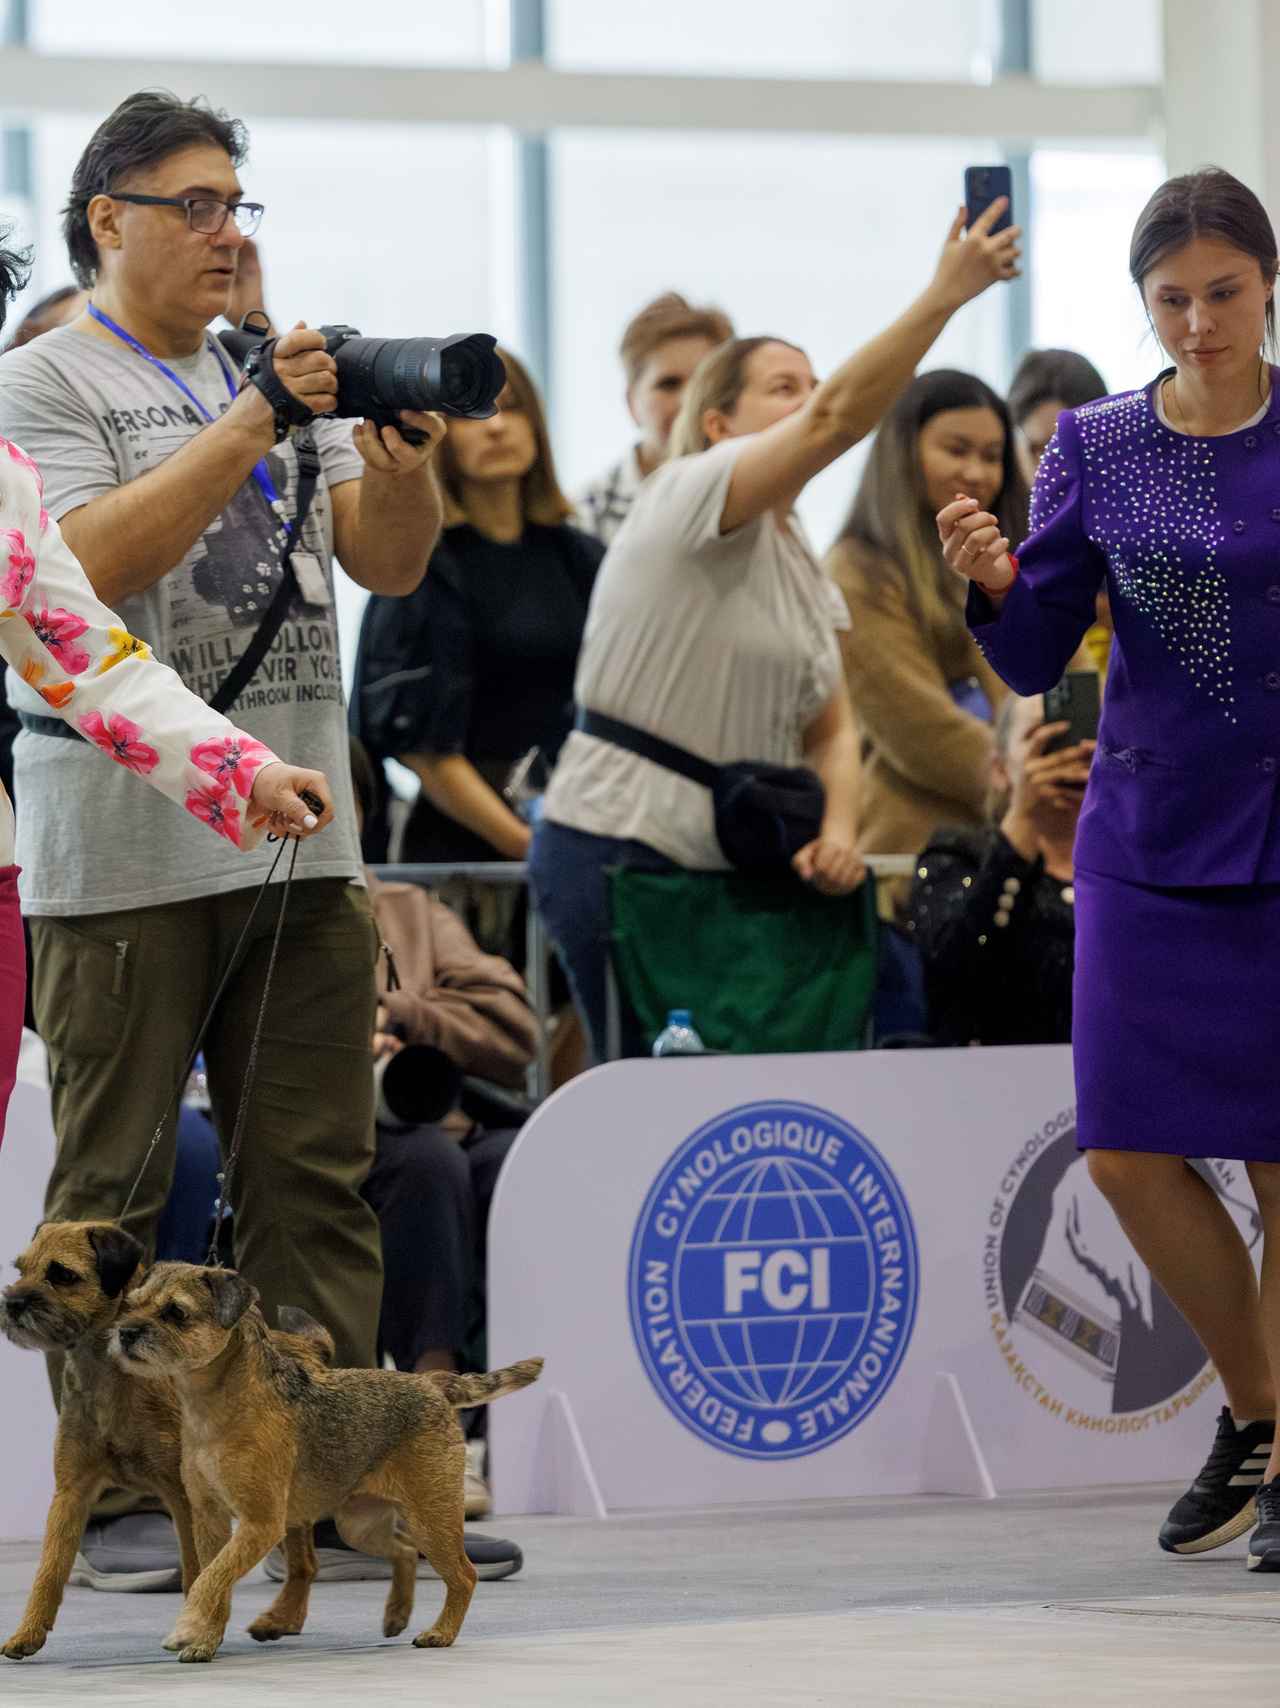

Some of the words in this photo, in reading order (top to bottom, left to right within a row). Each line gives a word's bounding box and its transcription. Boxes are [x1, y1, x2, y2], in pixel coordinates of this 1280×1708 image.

[101, 404, 204, 435] ERSONA
[170, 637, 241, 685] WILL
[655, 1120, 844, 1238] CYNOLOGIQUE
[1000, 1107, 1076, 1194] CYNOLOGI
[989, 1197, 1005, 1228] OF
[723, 1247, 831, 1314] FCI
[983, 1234, 1000, 1310] UNION
[644, 1260, 756, 1443] FEDERATION
